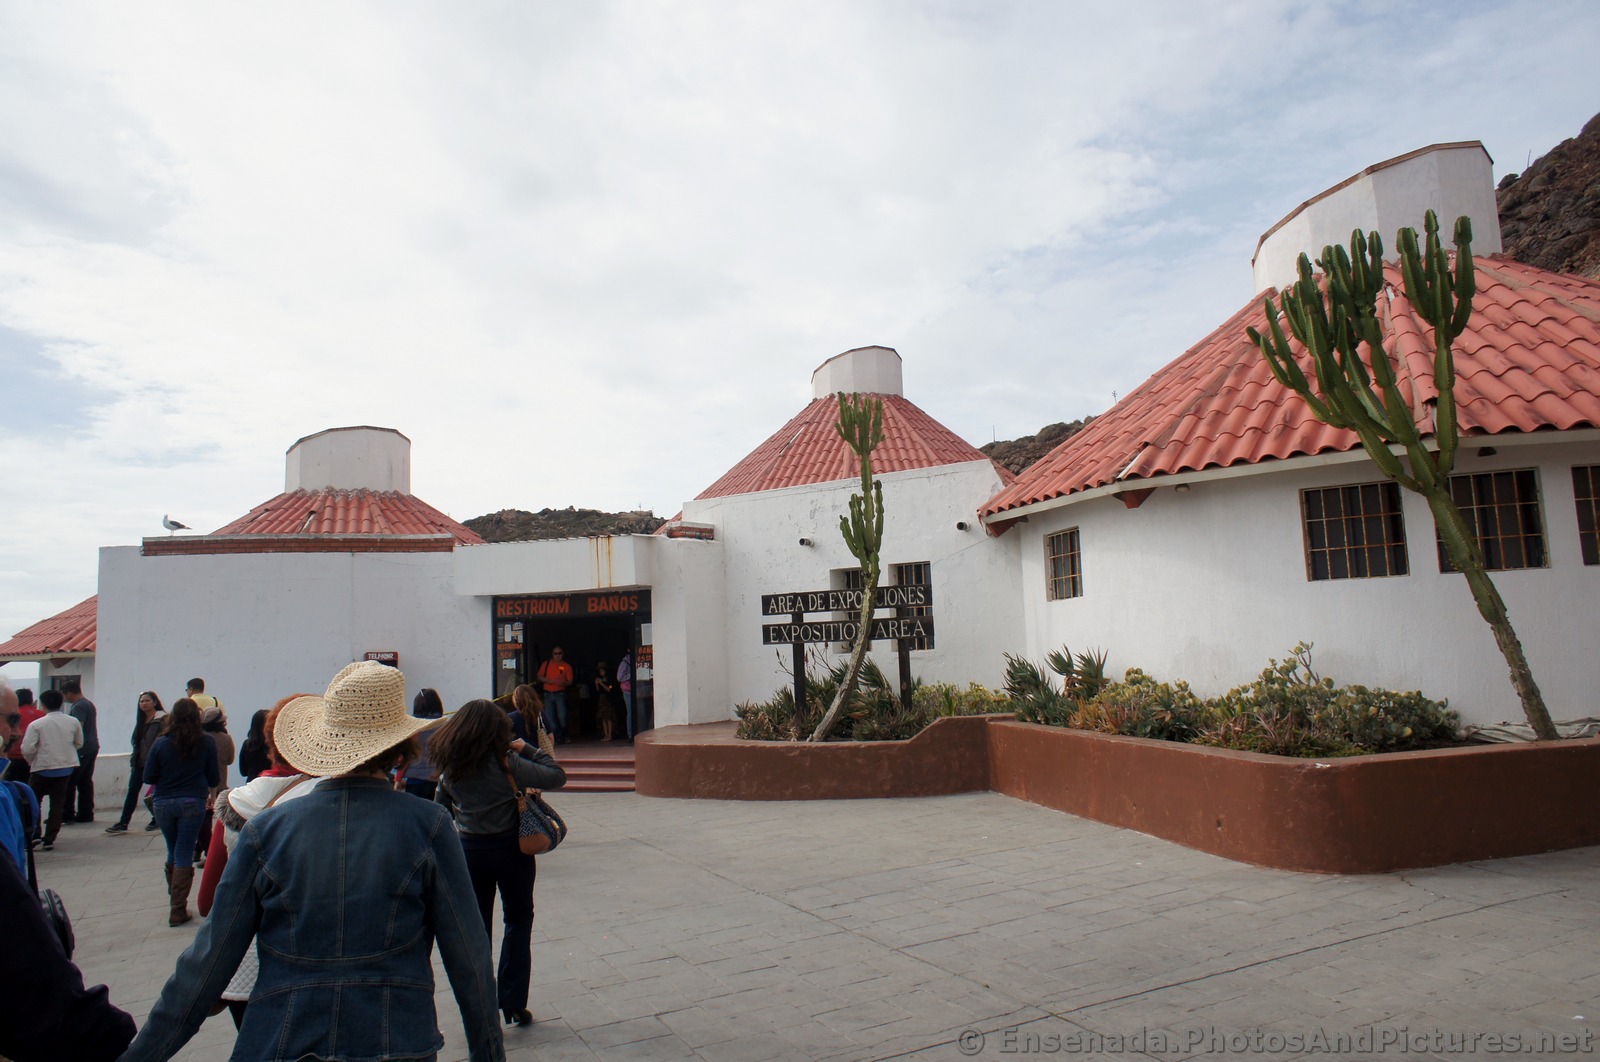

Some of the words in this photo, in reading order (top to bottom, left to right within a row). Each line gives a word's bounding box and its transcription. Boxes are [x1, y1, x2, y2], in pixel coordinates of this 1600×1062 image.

[497, 598, 569, 617] RESTROOM
[587, 595, 639, 613] BAÑOS
[768, 595, 805, 614] AREA
[808, 593, 825, 611] DE
[829, 587, 925, 610] EXPOCIONES
[769, 622, 862, 643] EXPOSITIO
[875, 619, 927, 638] AREA
